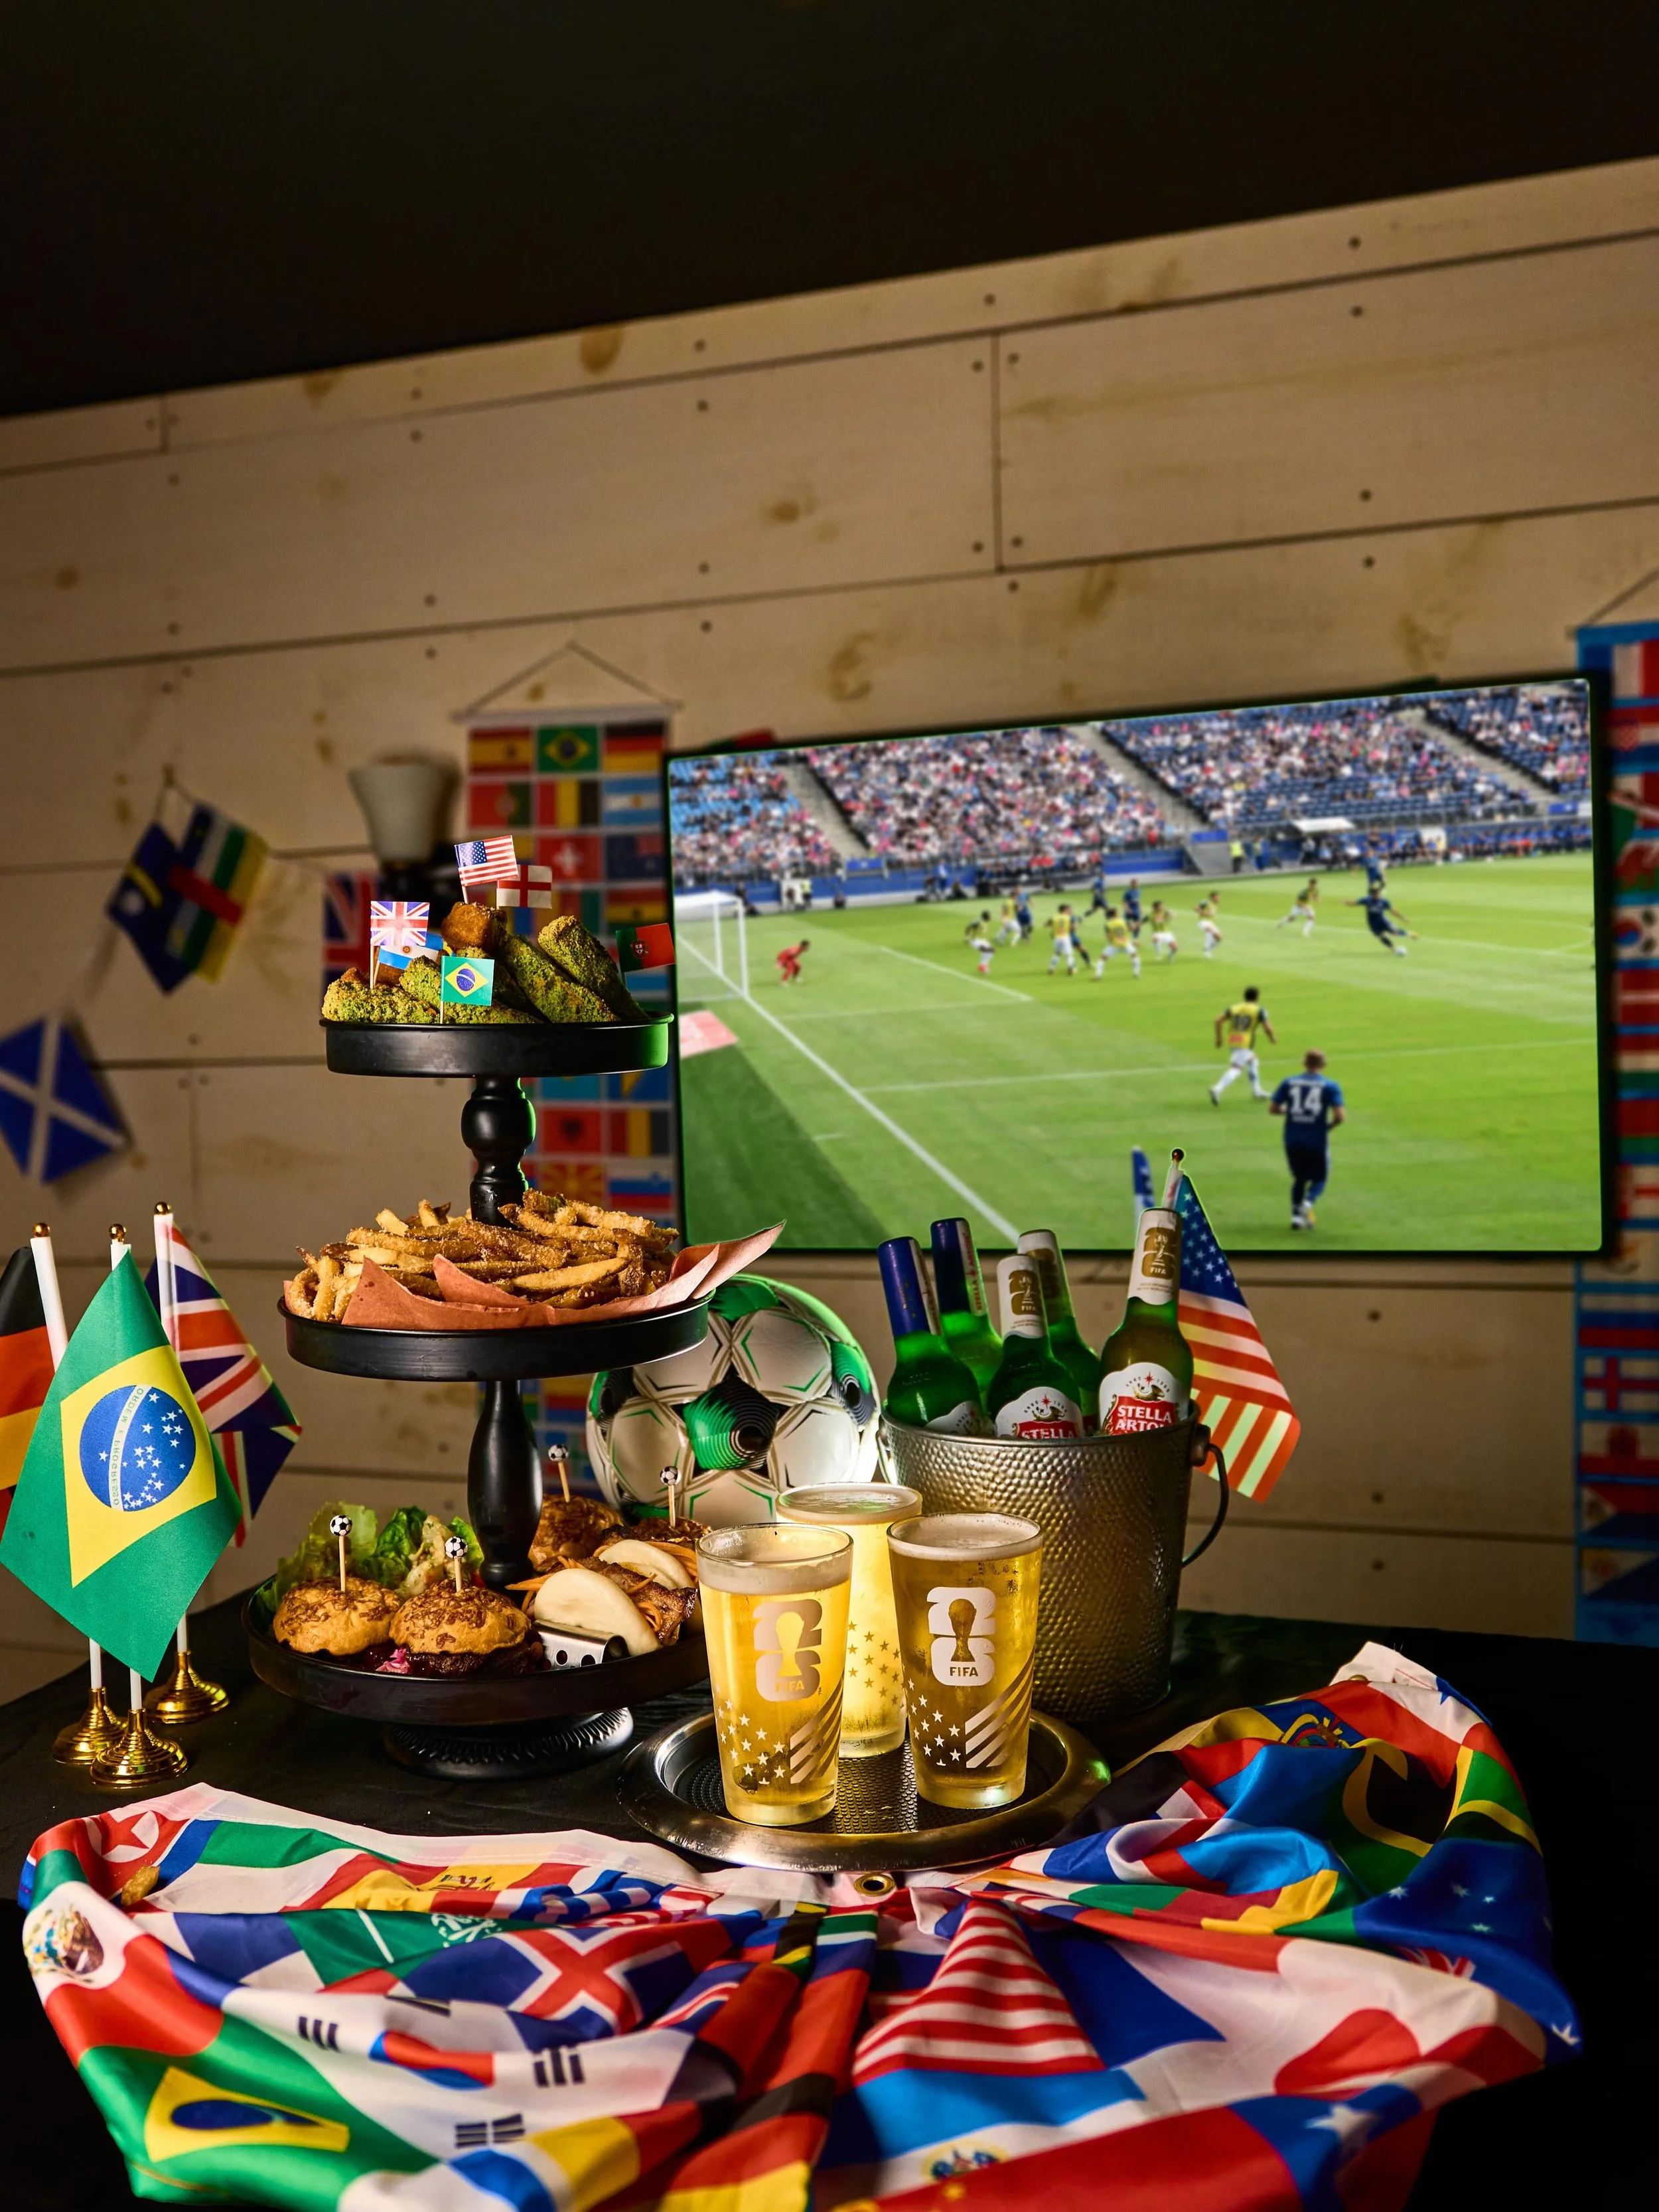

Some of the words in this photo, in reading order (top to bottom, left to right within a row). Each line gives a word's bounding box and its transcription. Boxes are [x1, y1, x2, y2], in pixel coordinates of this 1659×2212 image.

[1289, 1085, 1323, 1116] 14
[1117, 1405, 1173, 1424] STELLA
[1115, 1419, 1165, 1432] ARTO
[949, 1666, 979, 1677] FIFA
[775, 1680, 805, 1692] FIFA
